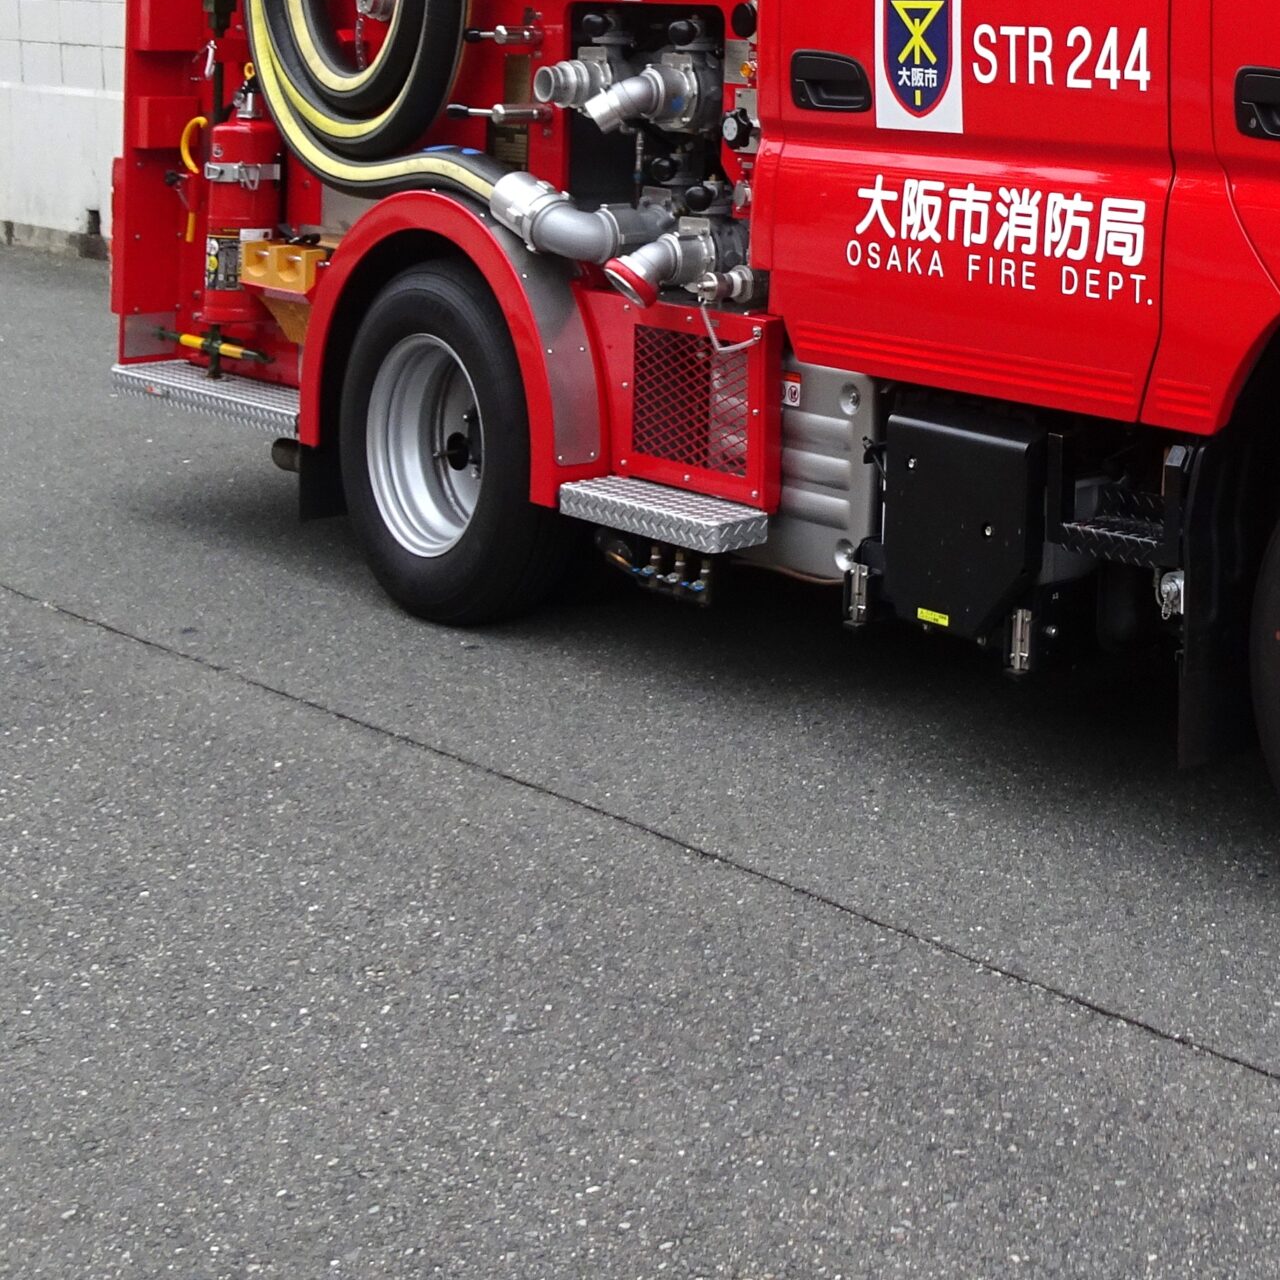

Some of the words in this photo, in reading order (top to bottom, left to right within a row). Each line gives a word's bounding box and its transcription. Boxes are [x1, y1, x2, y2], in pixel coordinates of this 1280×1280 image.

[897, 67, 938, 89] 大阪市
[972, 23, 1055, 86] STR
[1065, 25, 1151, 92] 244
[855, 174, 1146, 266] 大阪市消防局
[845, 239, 945, 279] OSAKA
[966, 253, 1037, 291] FIRE
[1061, 265, 1154, 306] DEPT.
